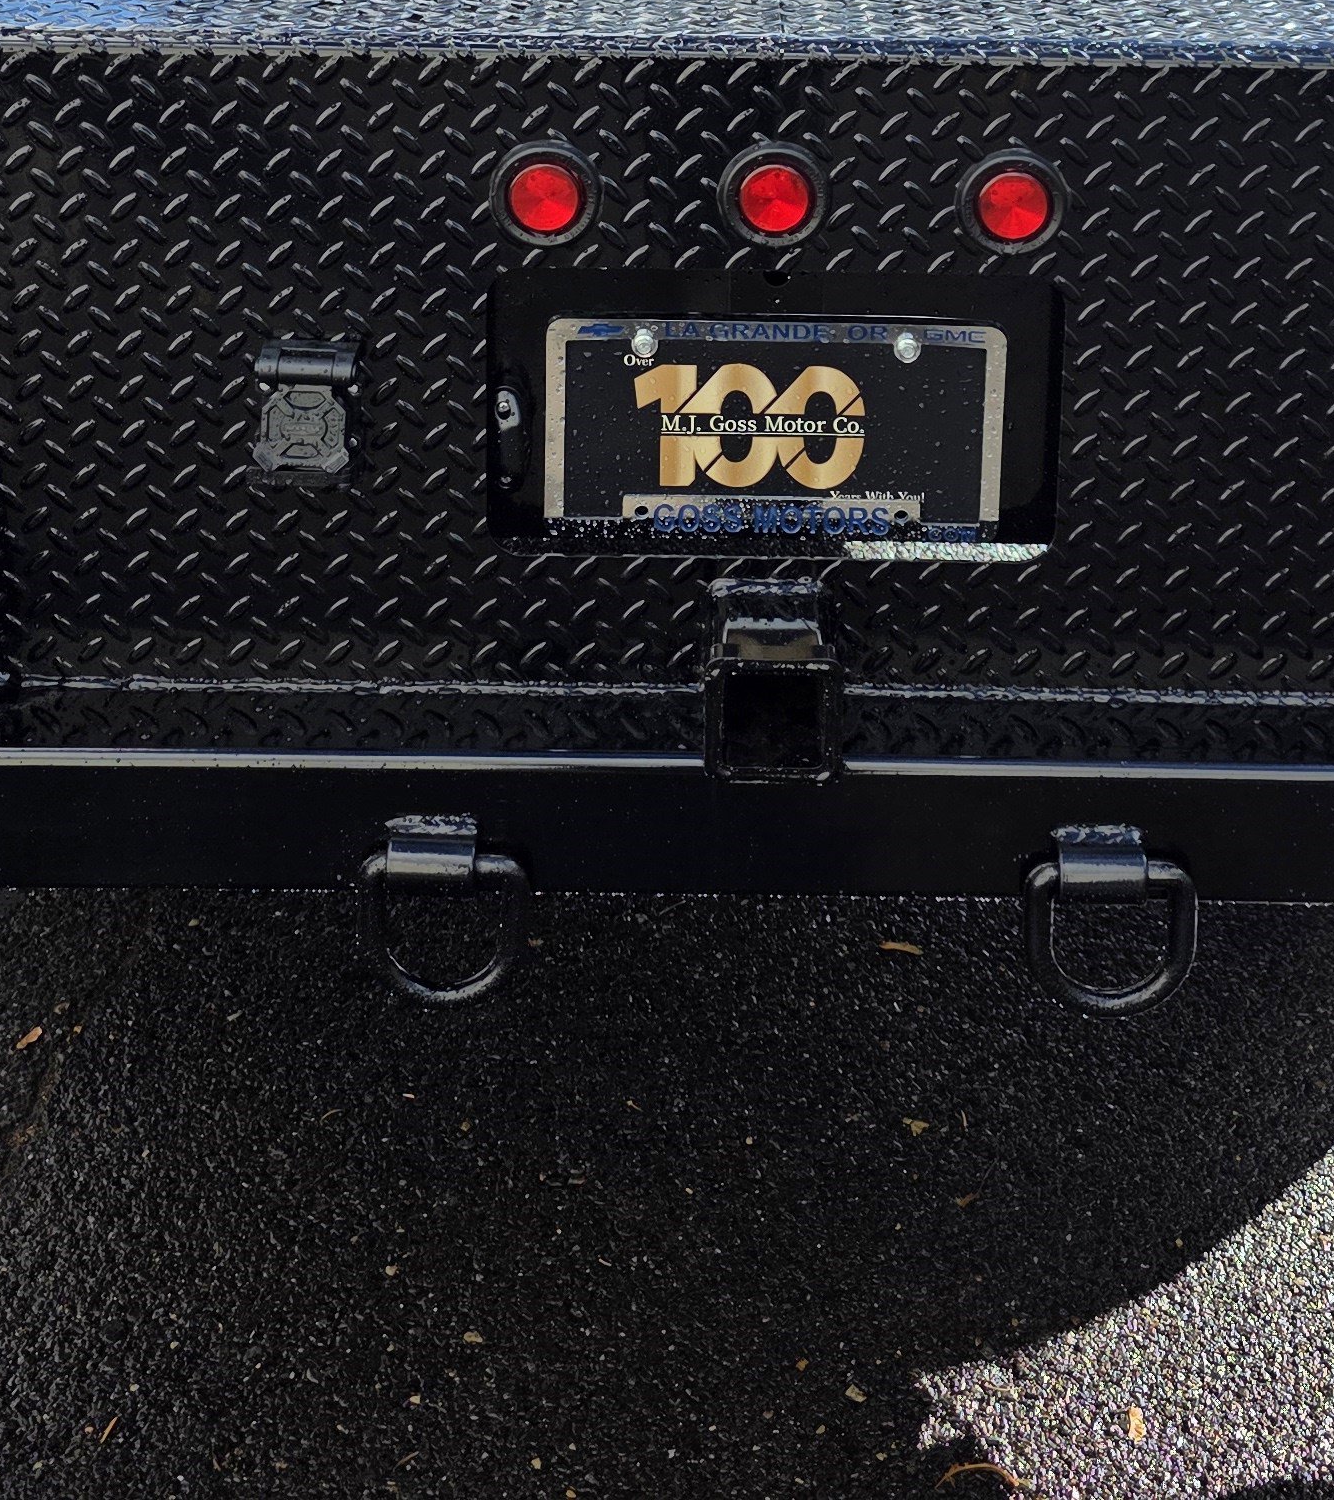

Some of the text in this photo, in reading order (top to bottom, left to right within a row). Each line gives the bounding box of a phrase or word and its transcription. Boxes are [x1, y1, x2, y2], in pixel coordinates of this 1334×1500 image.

[666, 321, 887, 342] LA GRANDE OR
[923, 329, 987, 343] GMC
[623, 354, 654, 368] Over
[633, 363, 866, 490] 100
[661, 414, 865, 434] M.J. Goss Motor Co.
[653, 504, 889, 536] GOSS MOTORS
